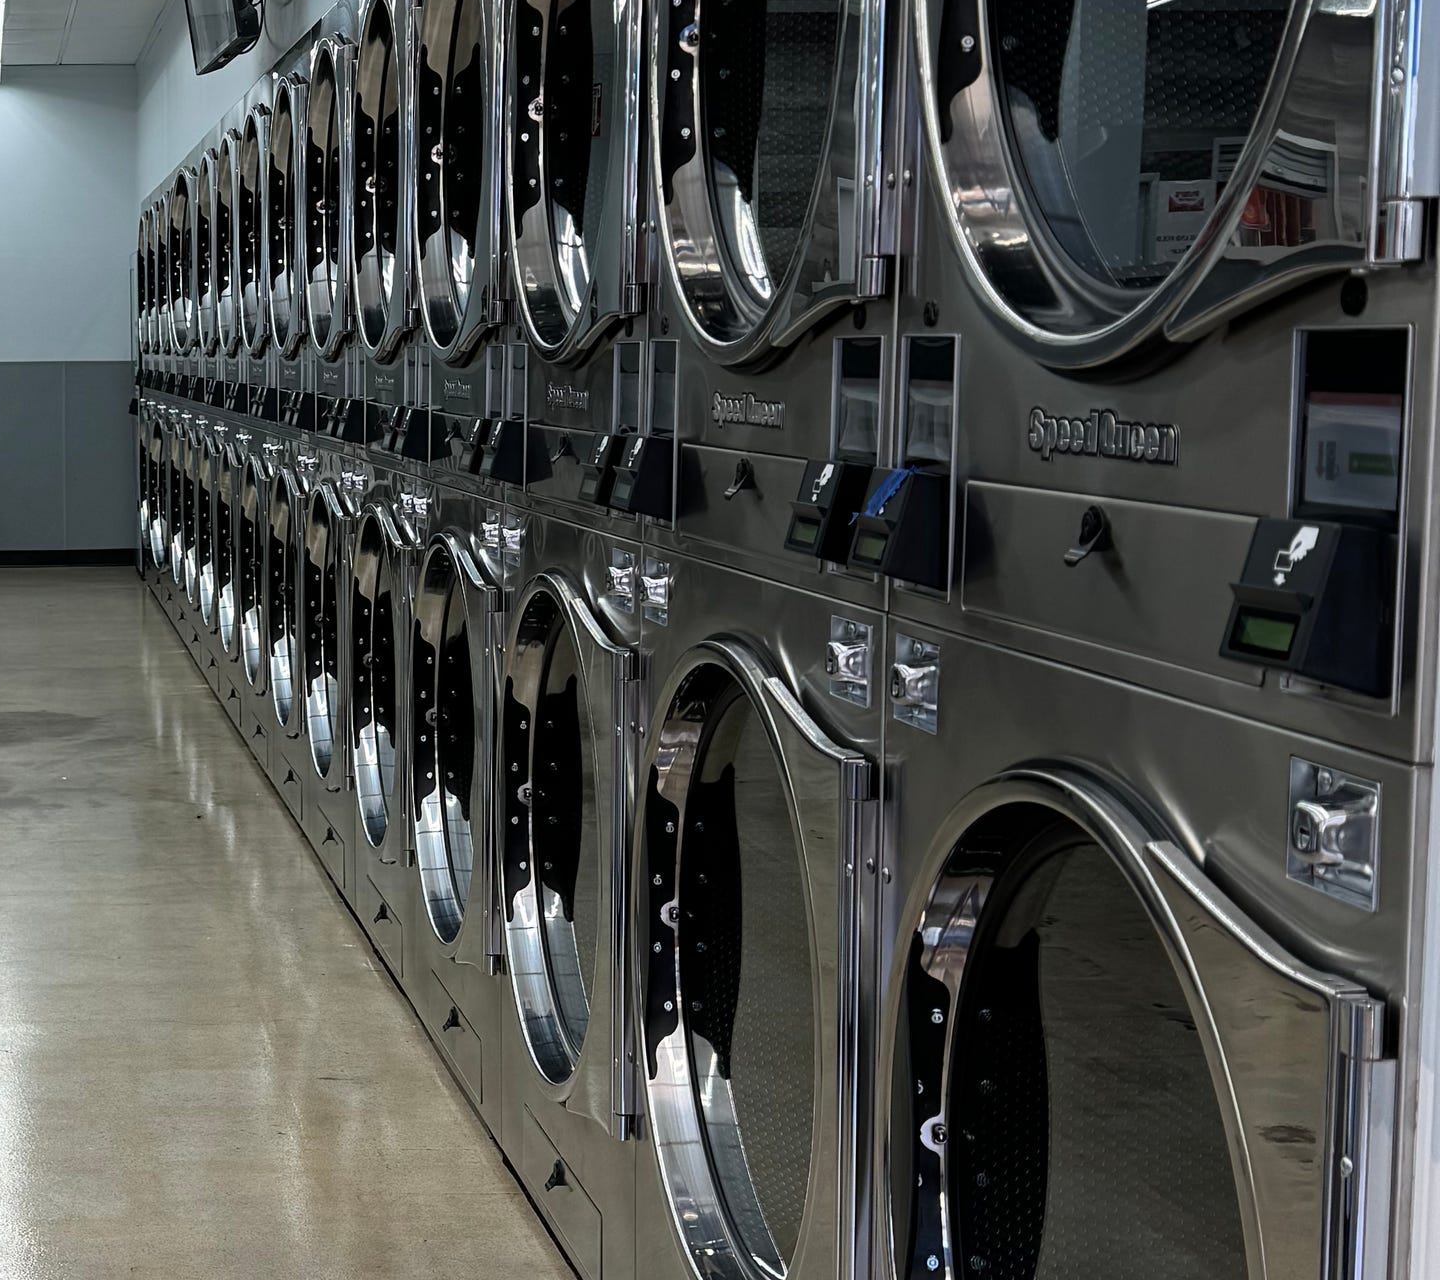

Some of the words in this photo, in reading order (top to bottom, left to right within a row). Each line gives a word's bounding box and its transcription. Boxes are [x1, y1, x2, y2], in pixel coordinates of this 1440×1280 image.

[713, 392, 746, 428] Speed
[746, 393, 784, 428] Queen
[1029, 407, 1100, 460] Speed
[1100, 409, 1178, 463] Queen
